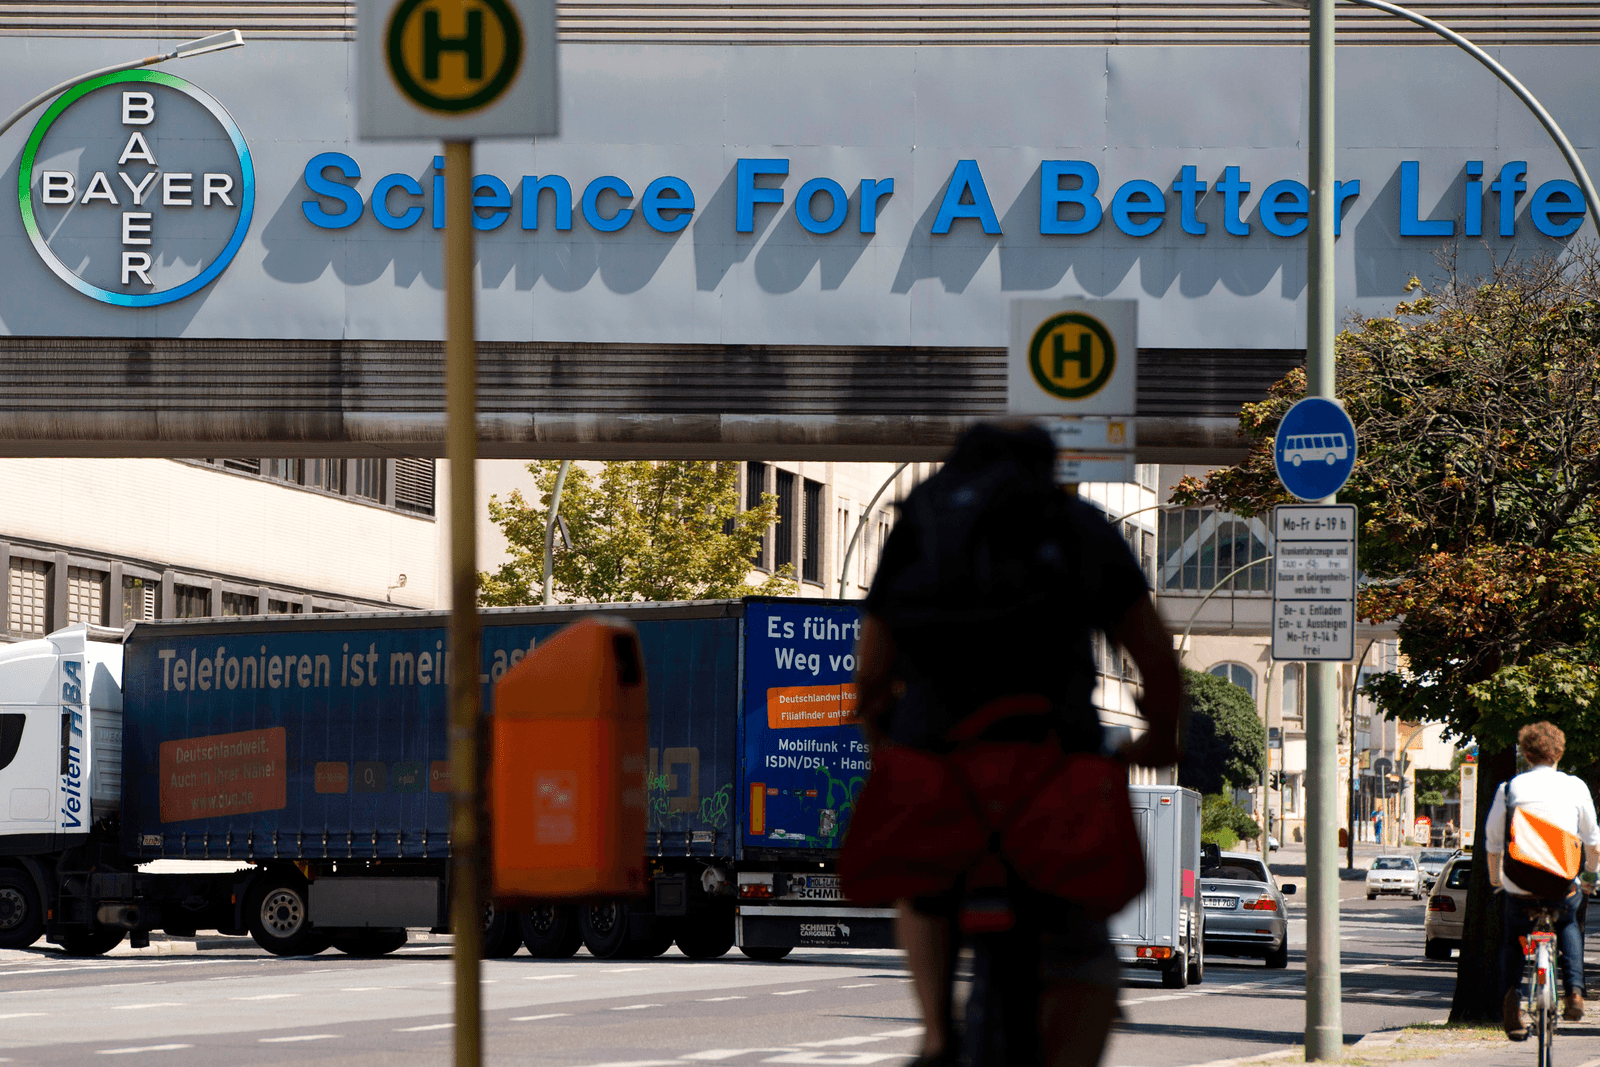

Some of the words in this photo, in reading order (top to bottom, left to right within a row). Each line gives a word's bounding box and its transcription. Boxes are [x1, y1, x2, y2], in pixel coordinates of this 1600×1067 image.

[41, 170, 237, 207] BAYER
[302, 151, 696, 233] Science
[736, 158, 894, 234] For
[930, 159, 1003, 235] A
[1039, 159, 1360, 237] Better
[1399, 160, 1587, 237] Life
[1283, 517, 1311, 531] Mo-Fr
[1315, 517, 1337, 531] 6-19
[1340, 517, 1347, 531] h
[1336, 546, 1348, 555] und
[1278, 572, 1295, 581] Busse
[1294, 585, 1318, 594] verkehr
[1320, 585, 1332, 594] frei
[1283, 604, 1297, 615] Be-
[1309, 604, 1342, 615] Entladen
[767, 616, 795, 639] Es
[803, 616, 861, 640] führt
[1278, 618, 1294, 629] Ein-
[1306, 618, 1347, 631] Aussteigen
[1286, 631, 1309, 642] Mo-Fr
[1312, 631, 1330, 642] 9-14
[1332, 631, 1338, 642] h
[1303, 644, 1321, 655] frei
[158, 644, 331, 691] Telefonieren
[341, 642, 379, 687] ist
[774, 647, 820, 676] Weg
[779, 691, 858, 704] Deutschlandweites
[780, 710, 825, 721] Filialfinder
[828, 709, 850, 719] unter
[176, 736, 270, 764] Deutschlandweit.
[778, 738, 839, 753] Mobilfunk
[849, 741, 870, 753] Fes
[765, 754, 829, 770] ISDN/DSL
[840, 757, 872, 770] Hand
[169, 770, 198, 789] Auch
[200, 769, 211, 786] in
[214, 765, 240, 784] Ihrer
[243, 760, 275, 780] Nähe!
[799, 888, 844, 899] SCHMIT
[800, 923, 836, 931] SCHMITZ
